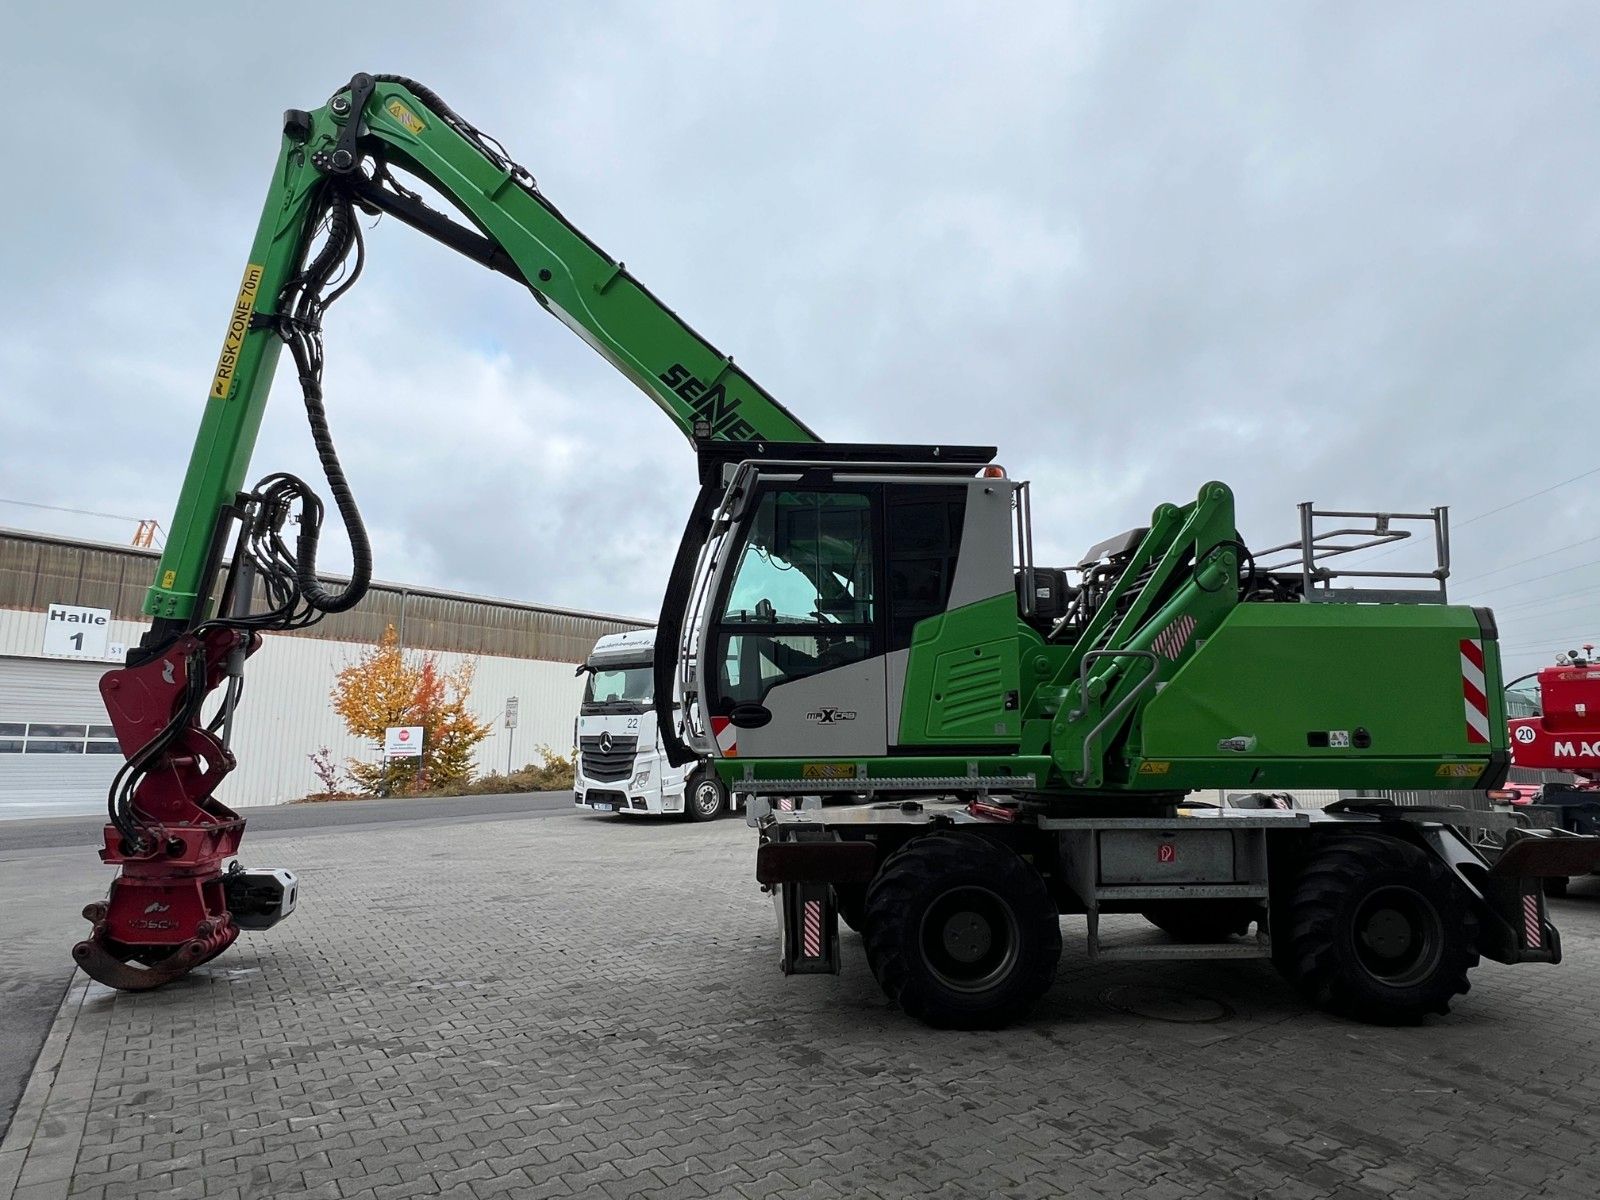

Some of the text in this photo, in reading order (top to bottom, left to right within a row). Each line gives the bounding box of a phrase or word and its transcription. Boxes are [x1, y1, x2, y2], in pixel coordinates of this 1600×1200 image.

[217, 269, 261, 379] RISK ZONE 70m
[50, 610, 107, 625] Halle
[69, 632, 84, 651] 1
[627, 718, 638, 729] 22
[1518, 729, 1533, 741] 20
